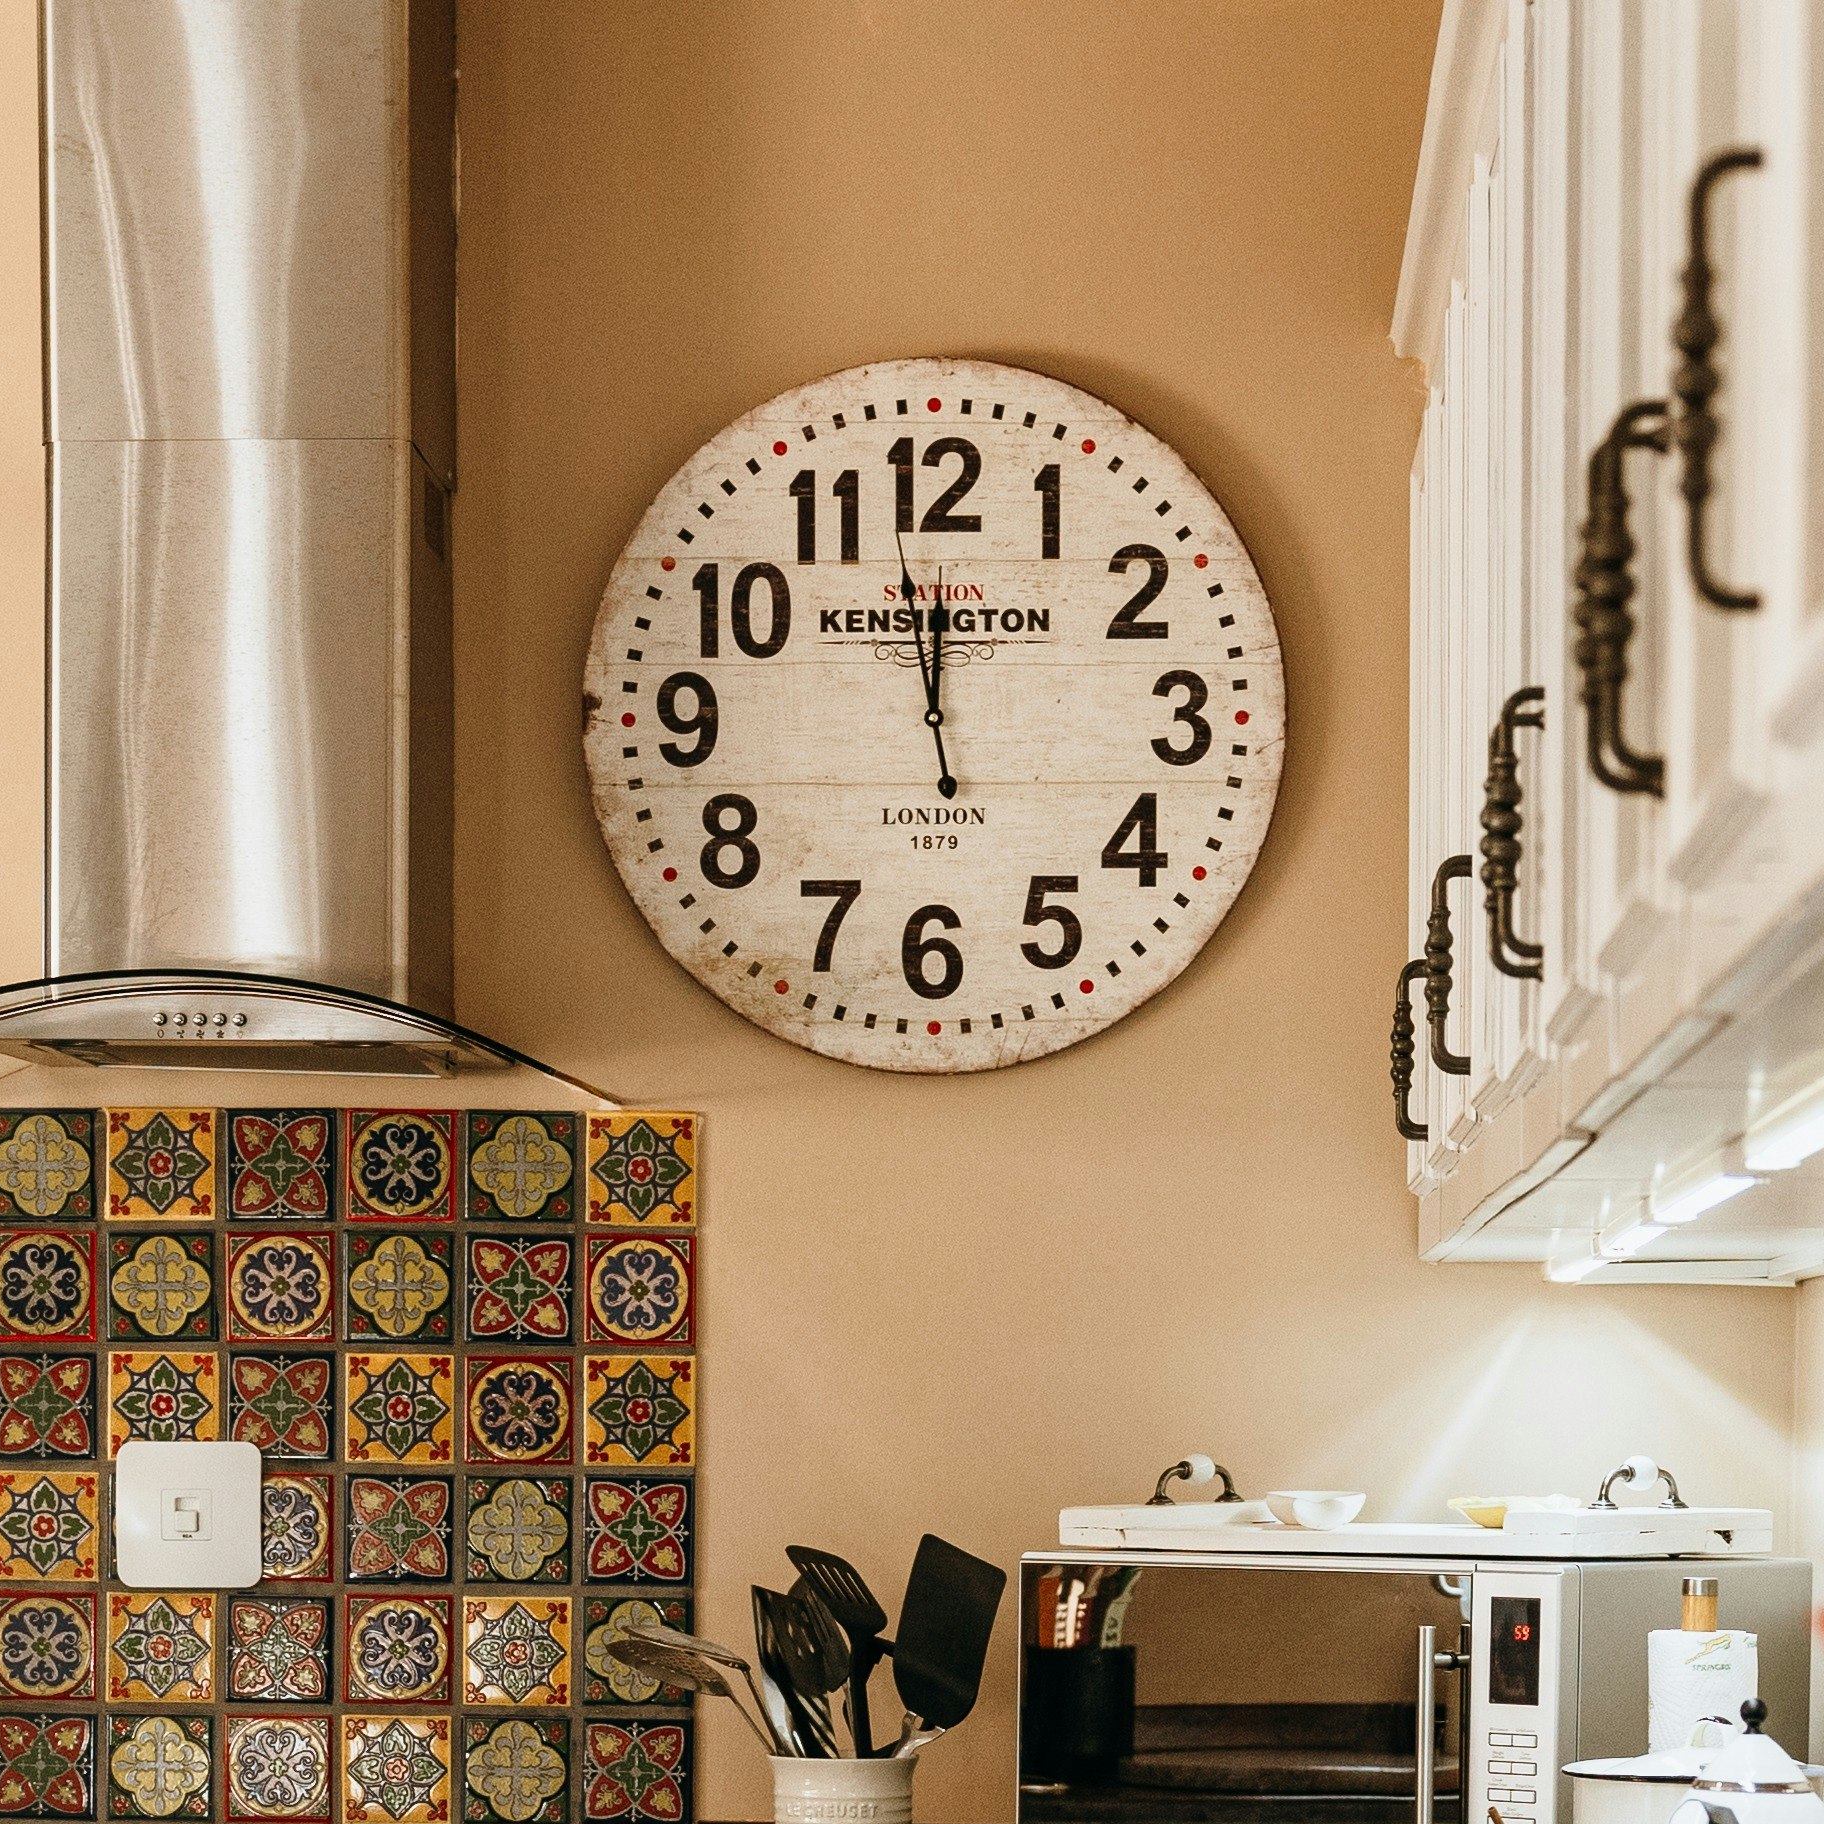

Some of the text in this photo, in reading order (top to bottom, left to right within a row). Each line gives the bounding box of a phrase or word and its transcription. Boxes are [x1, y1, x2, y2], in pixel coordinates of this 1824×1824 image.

[789, 469, 859, 565] 11
[887, 437, 982, 532] 12
[1034, 463, 1061, 560] 1
[692, 562, 792, 659] 10
[1105, 543, 1169, 640] 2
[656, 671, 719, 768] 9
[1150, 669, 1212, 766] 3
[699, 793, 761, 889] 8
[881, 807, 986, 825] LONDON
[910, 835, 958, 850] 1879
[1100, 792, 1169, 888] 4
[800, 879, 862, 973] 7
[901, 904, 964, 1000] 6
[1020, 875, 1083, 970] 5
